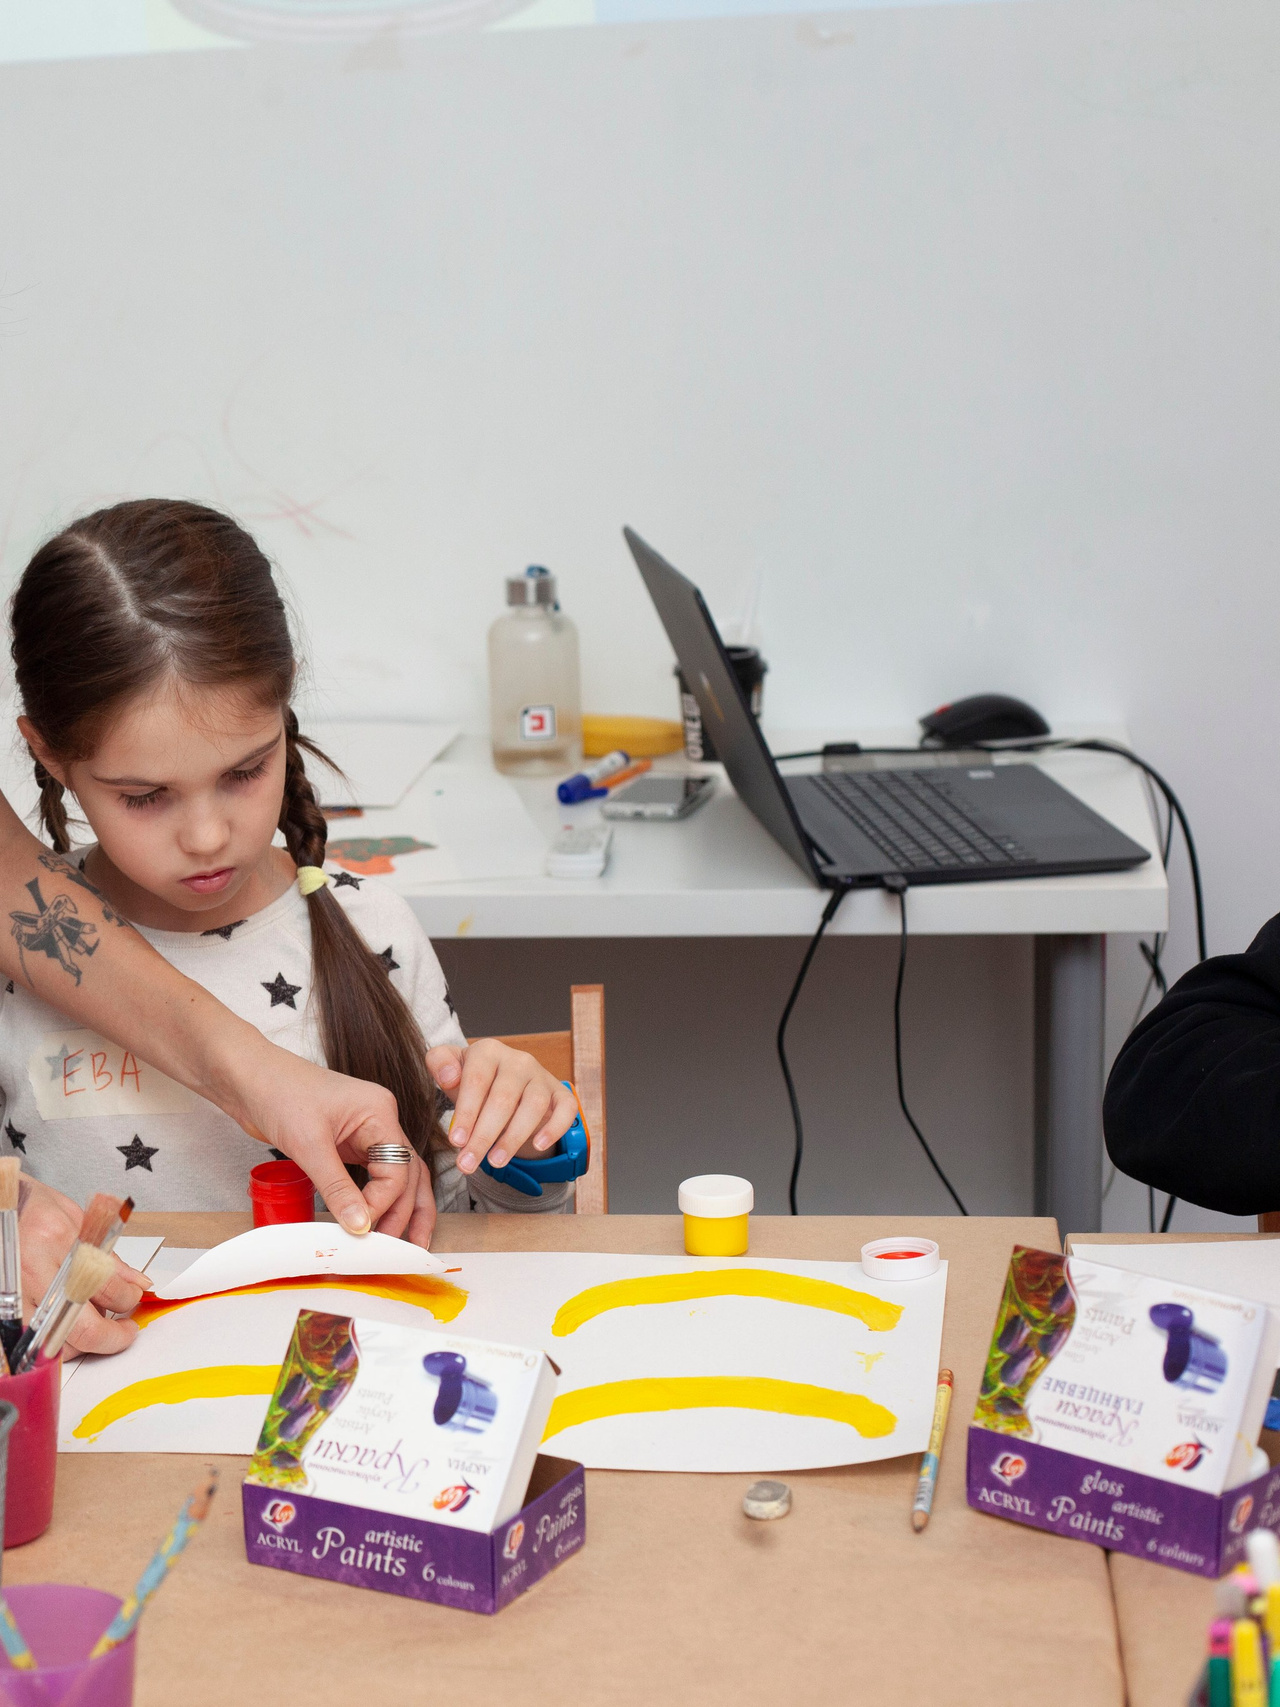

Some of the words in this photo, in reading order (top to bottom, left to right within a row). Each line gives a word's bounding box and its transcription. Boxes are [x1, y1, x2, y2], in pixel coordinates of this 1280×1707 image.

[63, 1048, 142, 1096] ЕВА
[313, 1438, 429, 1495] Краски
[1080, 1470, 1124, 1498] gloss
[978, 1487, 1035, 1517] ACRYL
[1047, 1496, 1125, 1542] Paints
[257, 1532, 303, 1554] ACRYL
[312, 1526, 407, 1577] Paints
[365, 1528, 423, 1553] artistic
[422, 1562, 436, 1582] 6
[436, 1573, 475, 1593] colours
